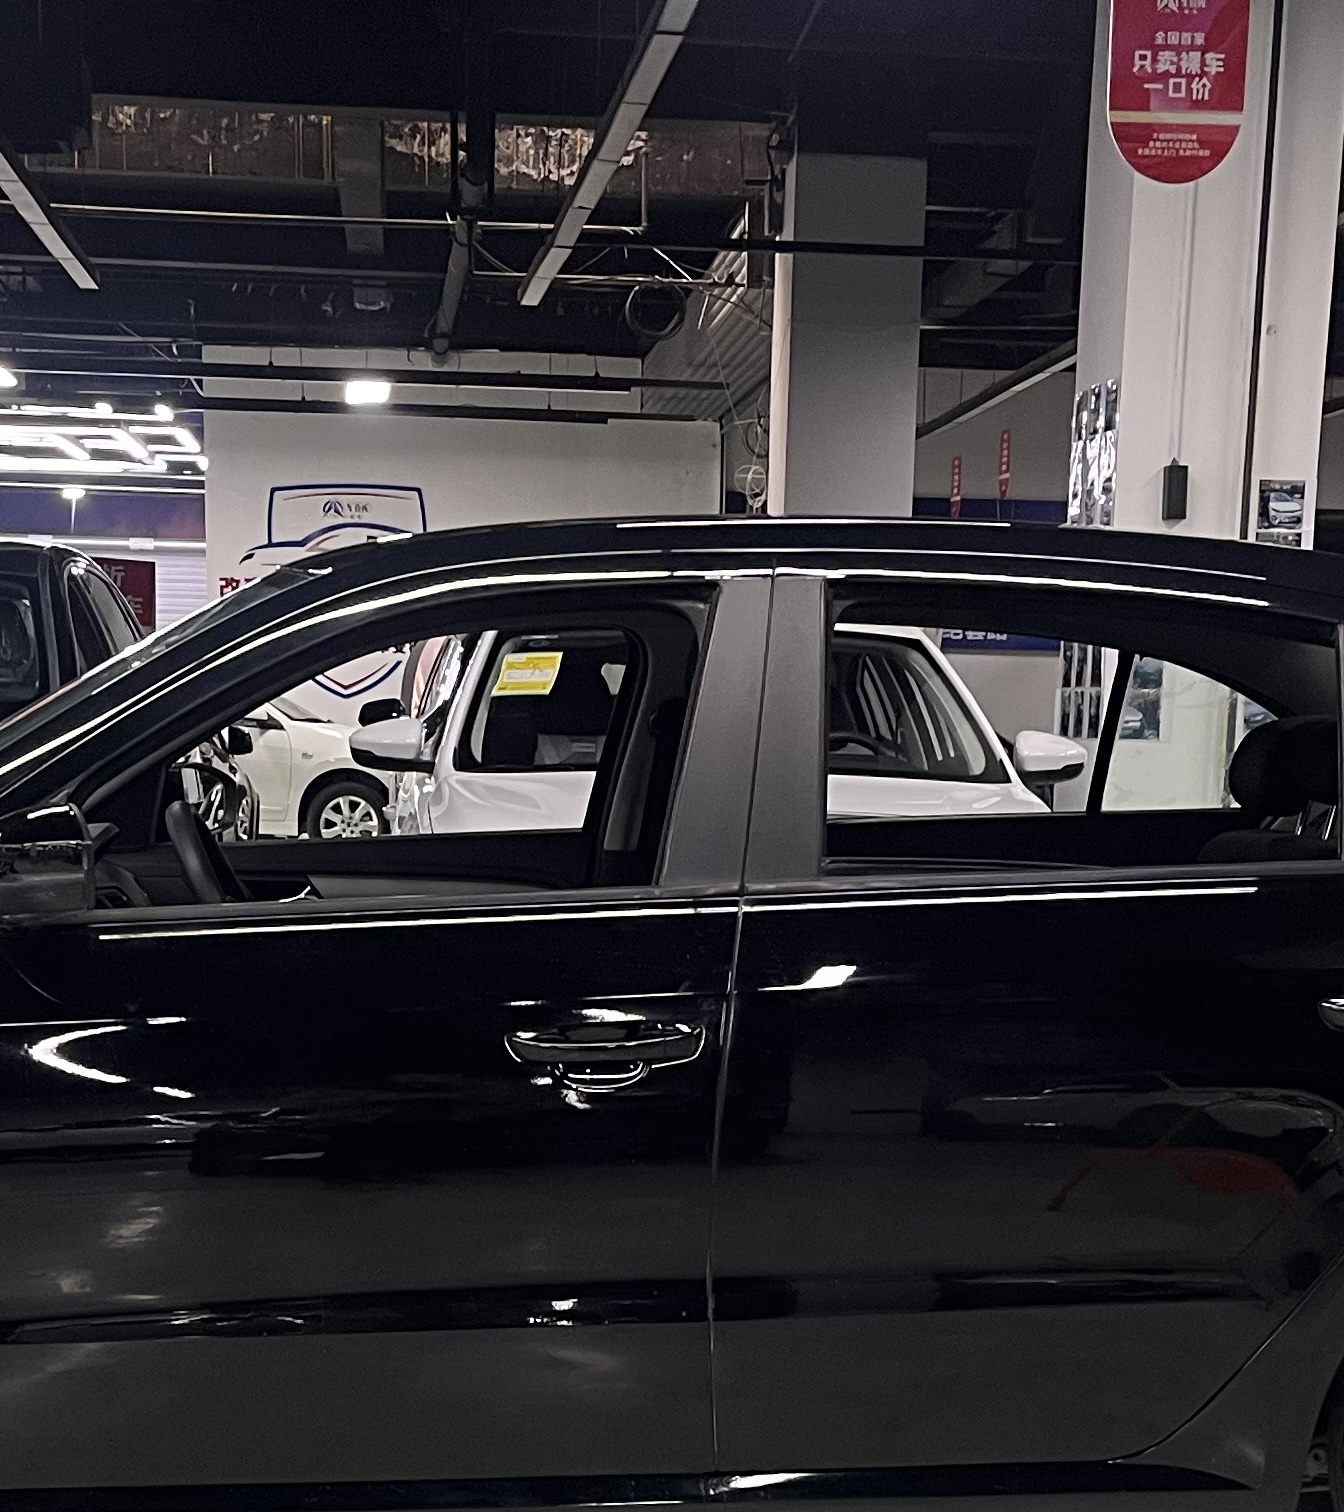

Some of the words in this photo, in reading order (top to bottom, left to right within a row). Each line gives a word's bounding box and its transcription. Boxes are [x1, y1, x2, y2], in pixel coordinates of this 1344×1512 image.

[1133, 50, 1225, 75] 只卖裸车
[1143, 76, 1212, 100] 一口价
